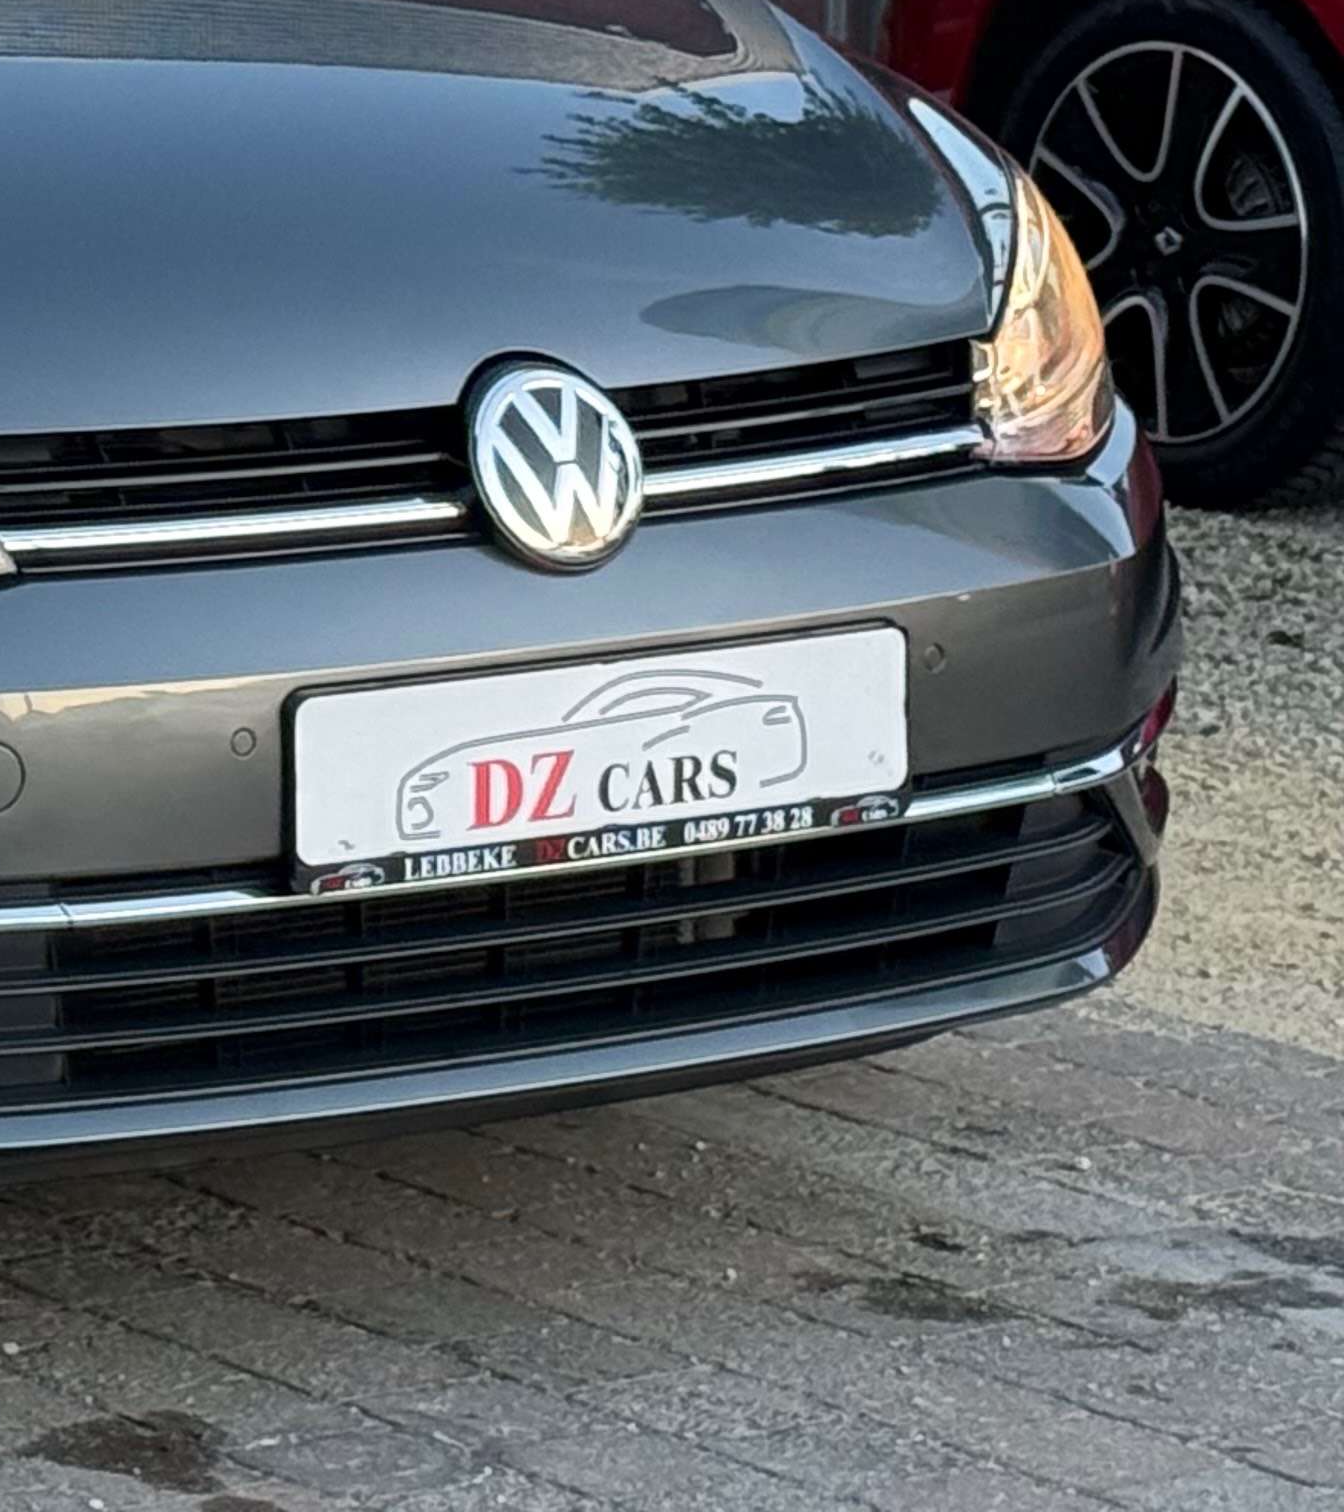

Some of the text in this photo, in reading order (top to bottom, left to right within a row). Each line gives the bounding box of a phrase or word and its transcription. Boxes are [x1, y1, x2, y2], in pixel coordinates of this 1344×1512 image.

[466, 749, 738, 831] DZ CARS
[403, 844, 518, 881] LEBBEKE
[683, 816, 730, 844] 0489
[734, 812, 758, 836] 77
[760, 809, 786, 834] 38
[788, 805, 813, 831] 28
